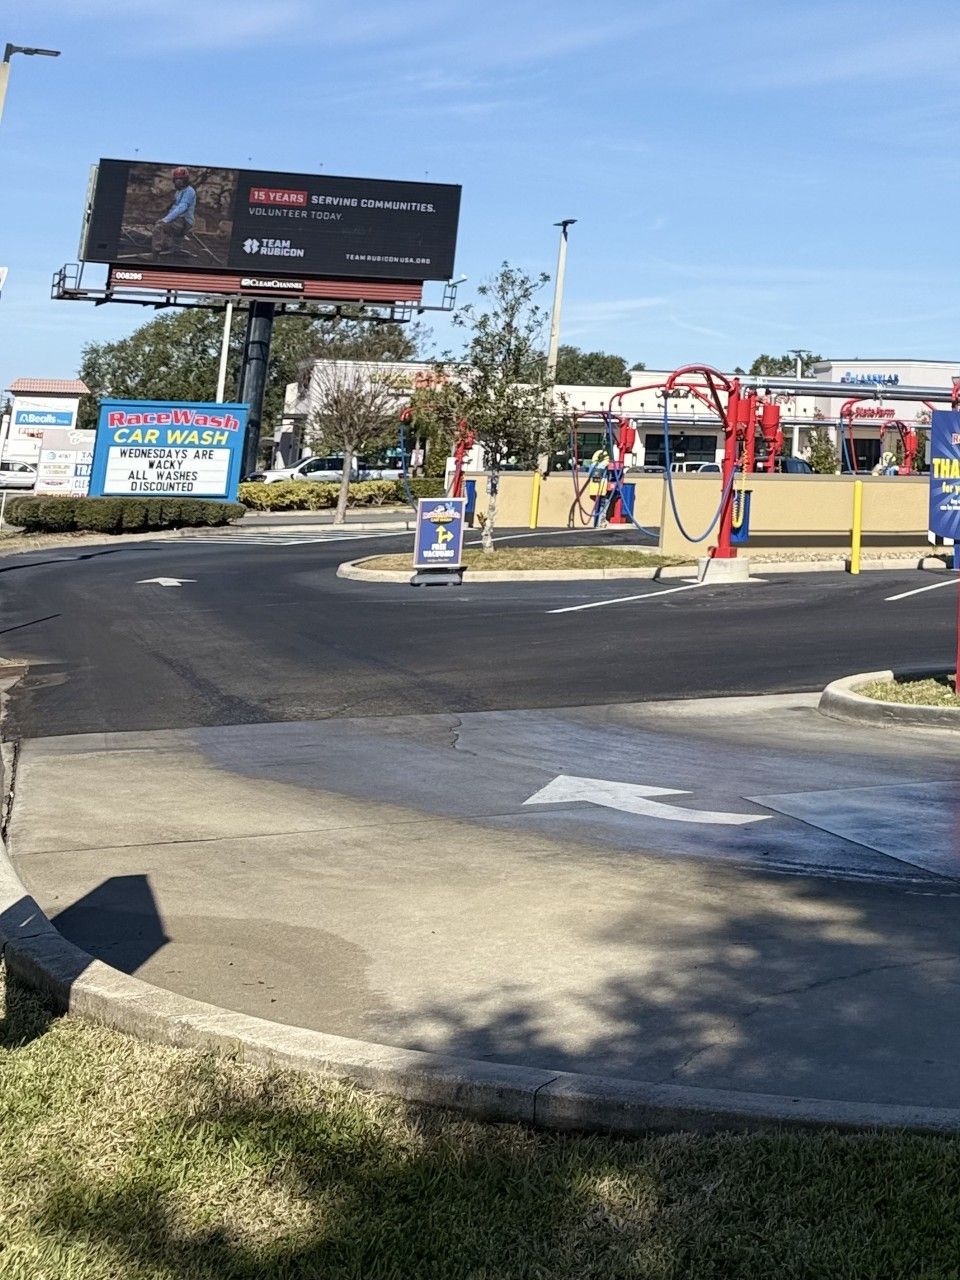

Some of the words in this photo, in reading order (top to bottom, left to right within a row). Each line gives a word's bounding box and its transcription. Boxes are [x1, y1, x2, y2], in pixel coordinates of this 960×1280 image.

[253, 190, 266, 200] 15
[269, 191, 304, 203] YEARS
[311, 195, 358, 207] SERVING
[361, 198, 437, 213] COMMUNITIES.
[249, 206, 308, 219] VOLUNTEER
[262, 238, 291, 248] TEAM
[260, 246, 305, 257] RUBICON
[108, 409, 240, 432] RaceWash
[113, 429, 160, 444] CAR
[166, 430, 229, 446] WASH
[120, 448, 188, 459] WEDNESDAYS
[193, 450, 215, 460] ARE
[148, 460, 184, 470] WACKY
[128, 470, 149, 481] ALL
[156, 472, 198, 482] WASHES
[130, 481, 194, 493] DISCOUNTED
[942, 481, 954, 493] for
